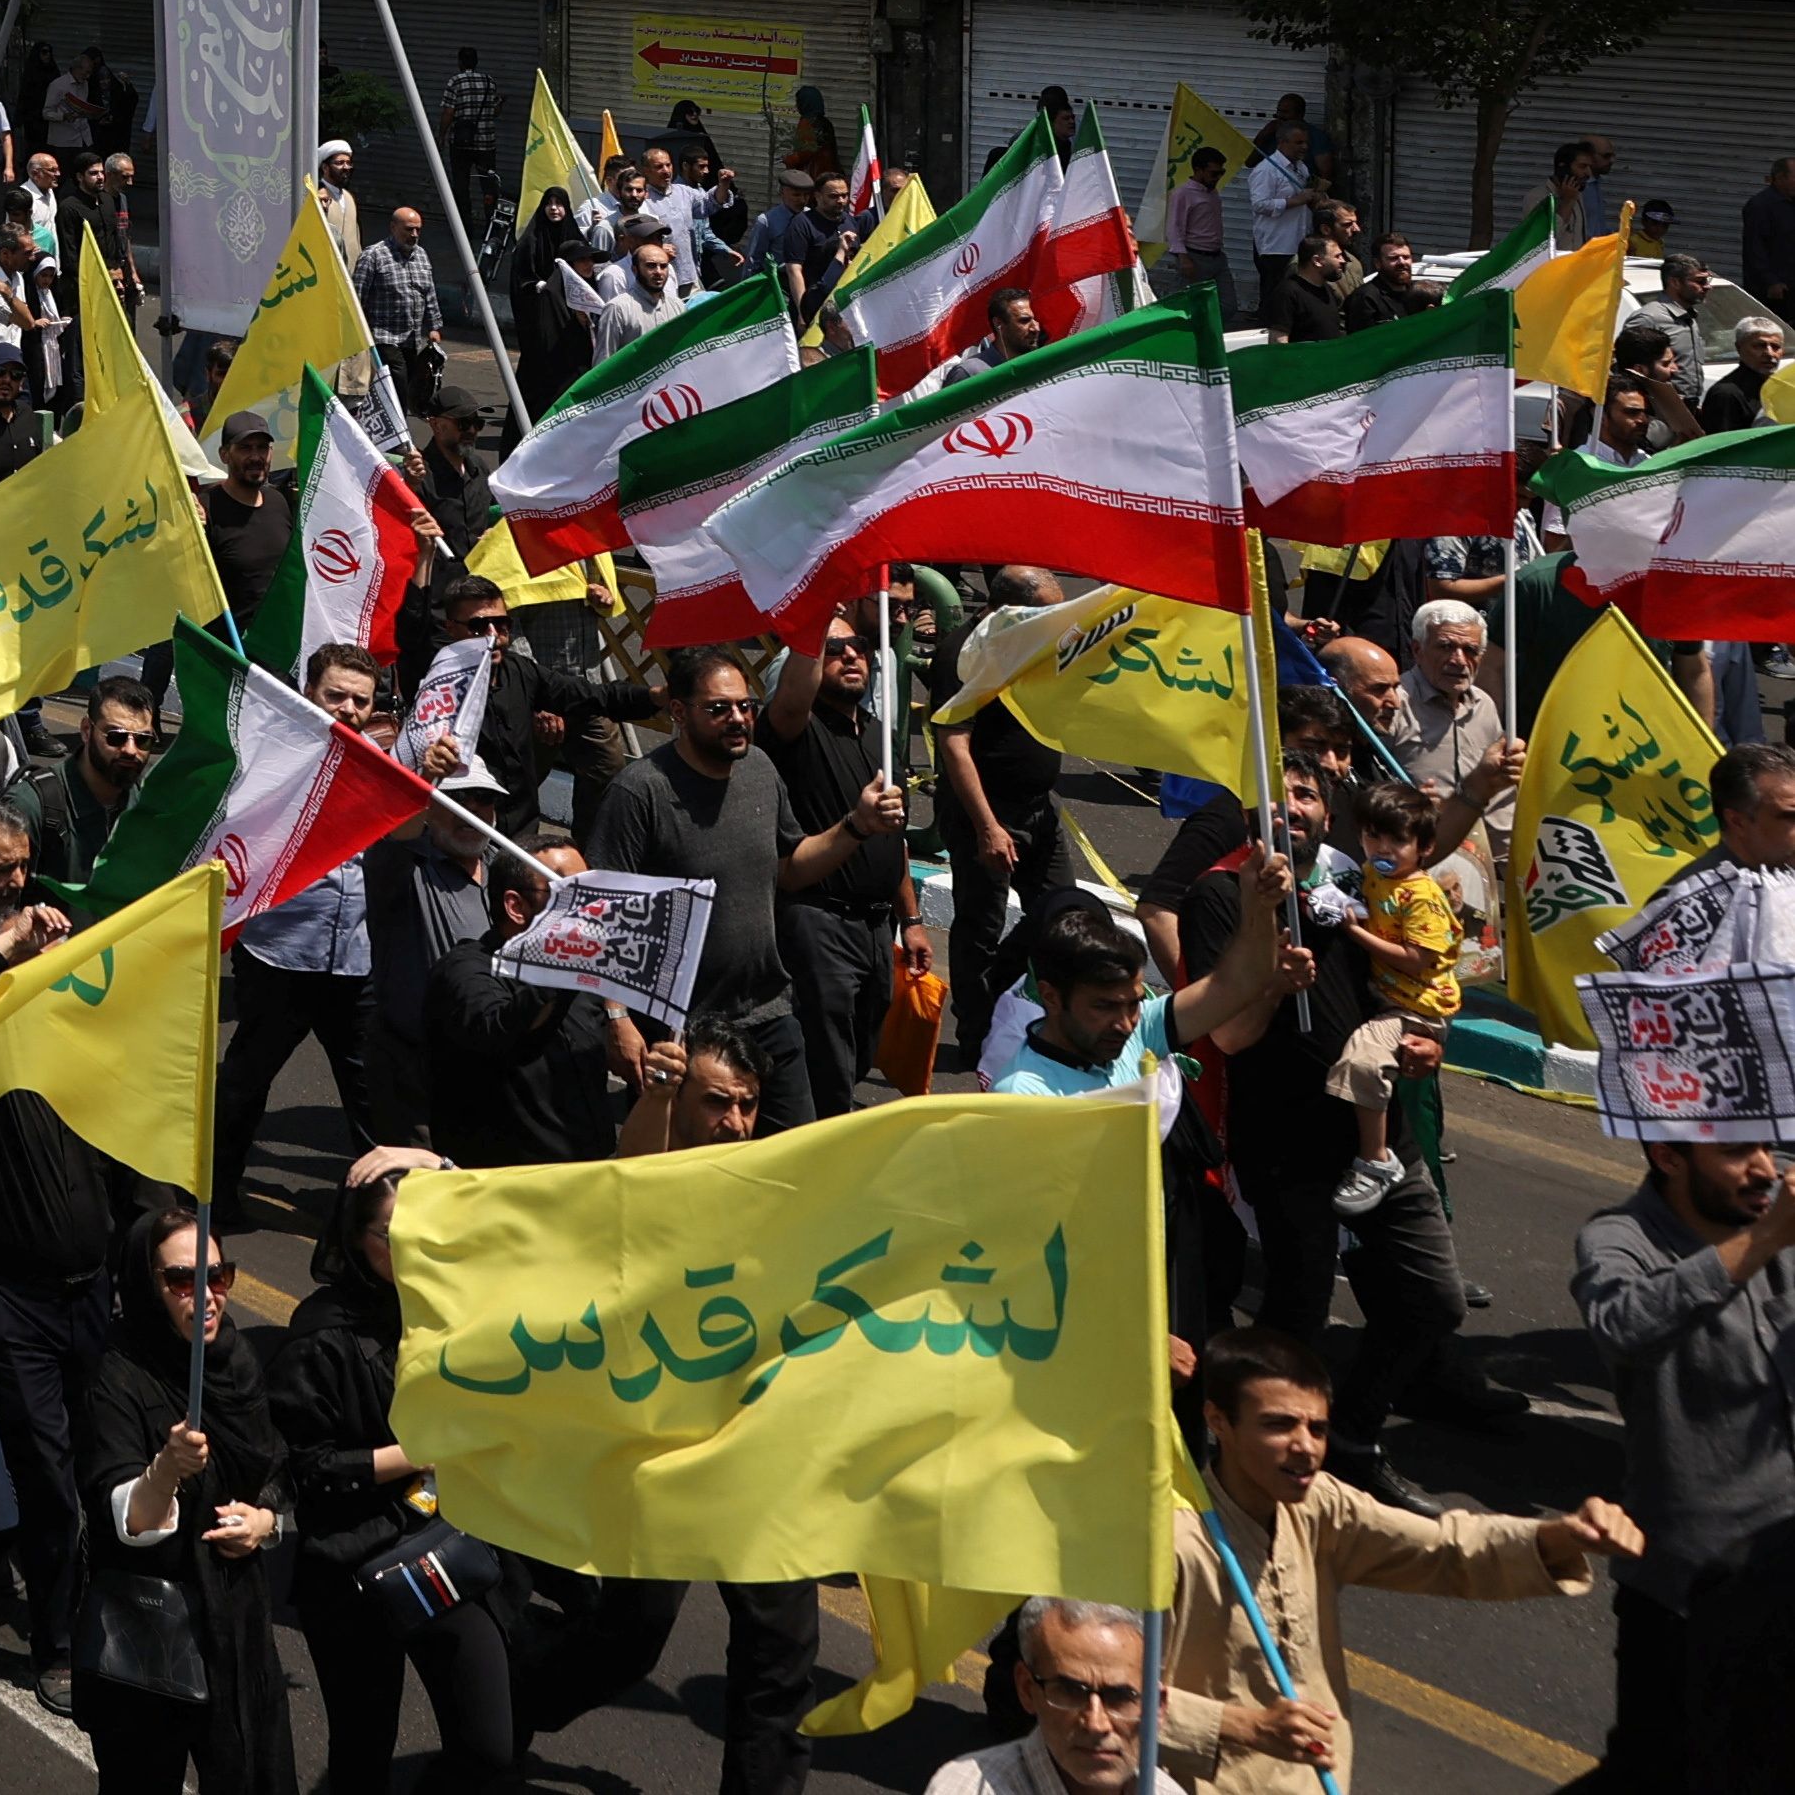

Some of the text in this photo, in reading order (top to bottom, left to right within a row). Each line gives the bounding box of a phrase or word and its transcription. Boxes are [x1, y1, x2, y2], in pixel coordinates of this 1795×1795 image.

[76, 475, 160, 612] لشکر
[1085, 626, 1235, 701] لشکر
[1560, 689, 1661, 825] لشکر
[438, 1221, 1065, 1406] لشکر قدس
